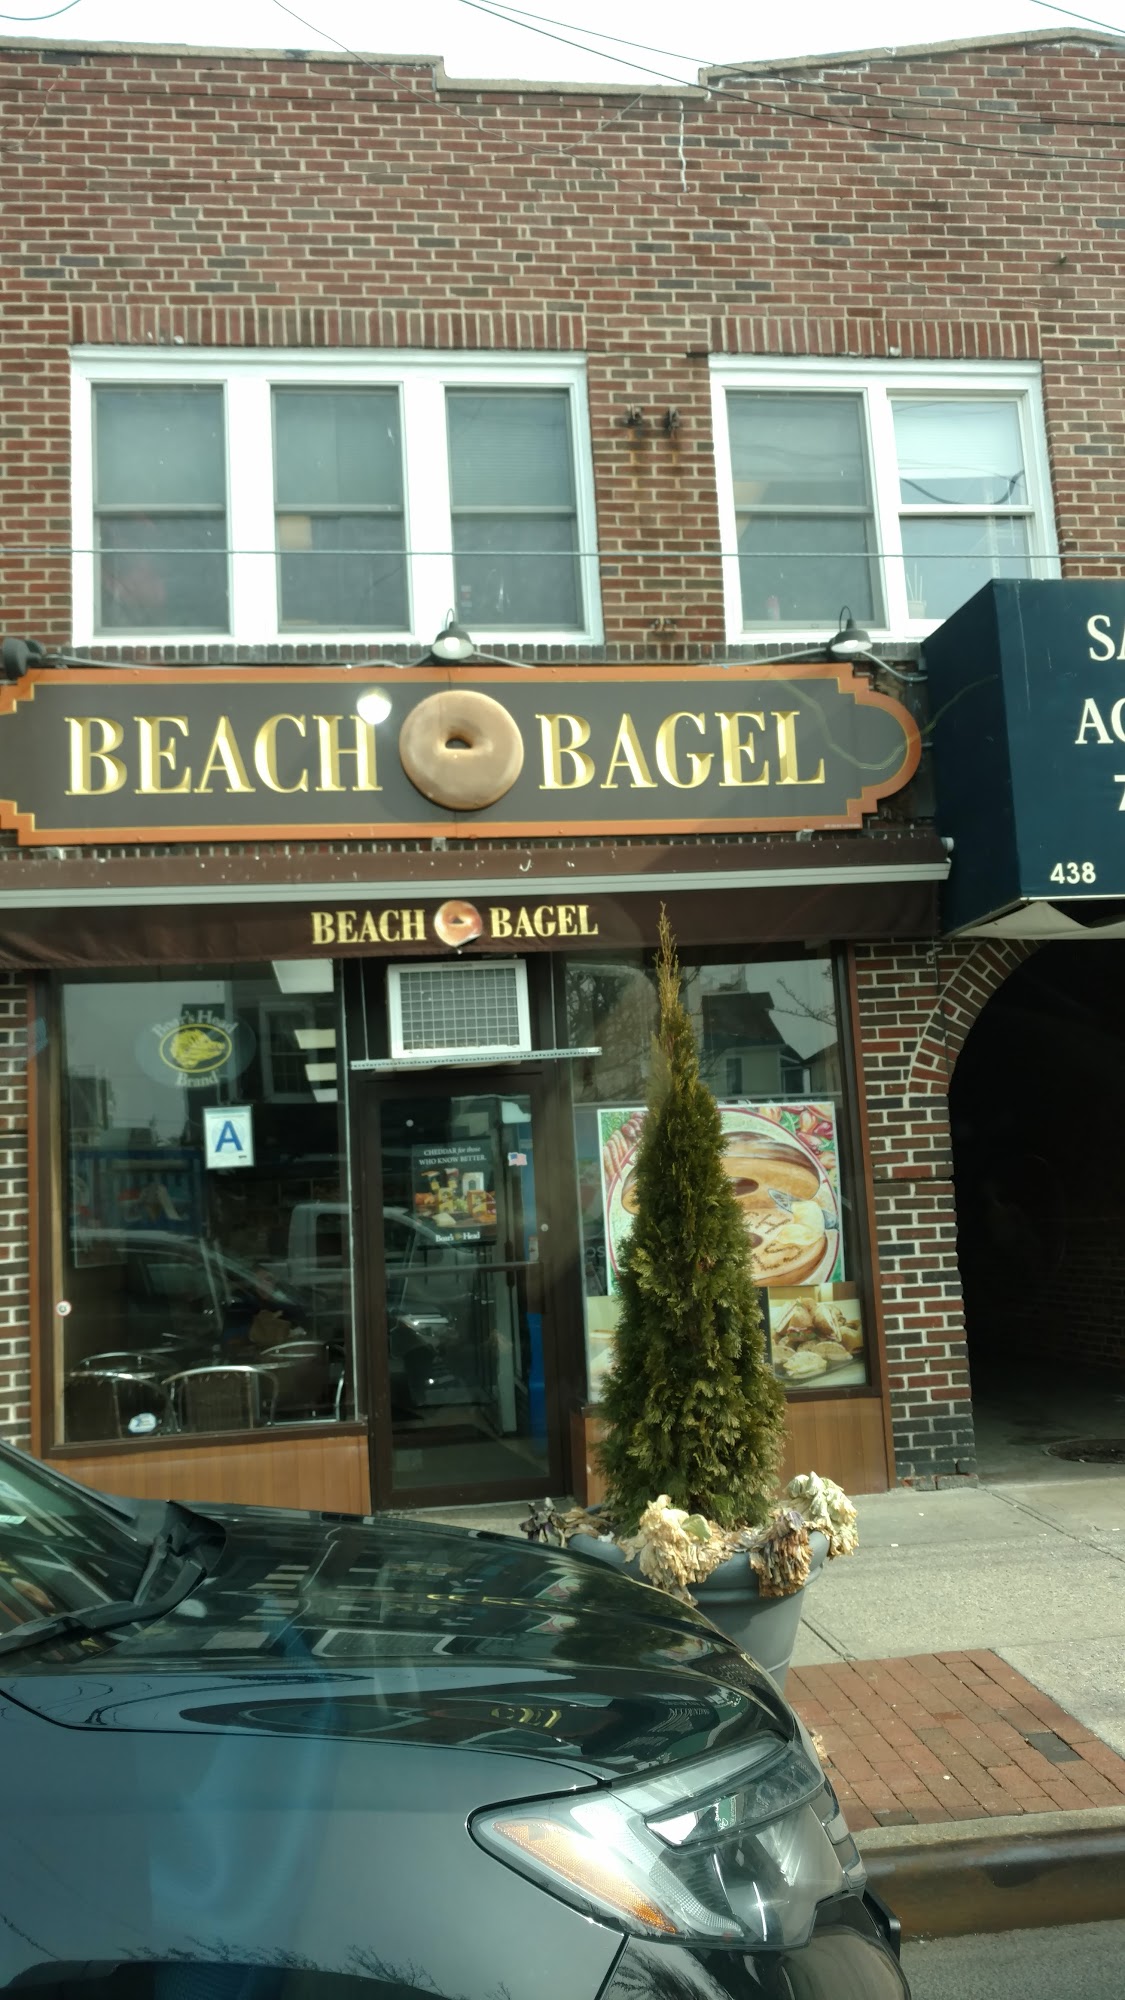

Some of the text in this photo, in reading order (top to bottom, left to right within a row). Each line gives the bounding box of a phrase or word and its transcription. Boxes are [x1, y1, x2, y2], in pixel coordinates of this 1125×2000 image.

[1087, 613, 1125, 662] S
[64, 709, 827, 796] BEACH BAGEL
[1049, 860, 1097, 885] 438
[310, 904, 600, 946] BEACH BAGEL
[196, 1009, 239, 1034] Head
[175, 1070, 219, 1088] Brand
[215, 1119, 244, 1153] A
[418, 1158, 437, 1166] WHO
[437, 1156, 459, 1165] KNOW
[462, 1231, 480, 1240] Head
